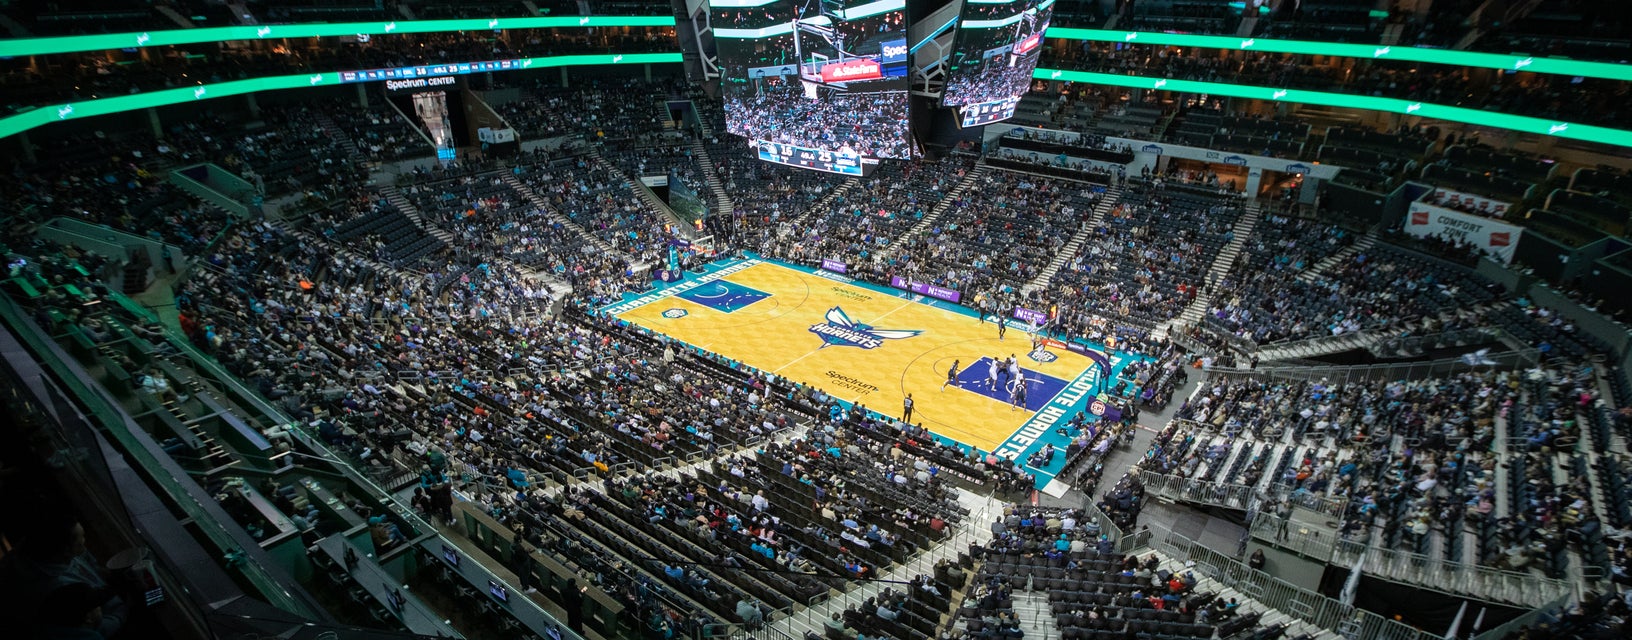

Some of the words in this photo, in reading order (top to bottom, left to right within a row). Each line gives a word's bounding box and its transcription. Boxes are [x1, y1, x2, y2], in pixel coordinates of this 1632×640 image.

[883, 45, 907, 58] Spec
[386, 80, 427, 91] Spectrum
[428, 76, 455, 86] CENTER
[781, 146, 793, 157] 16
[818, 151, 832, 162] 25
[1437, 215, 1484, 233] COMFORT
[605, 281, 698, 314] CHARLOTTE
[697, 259, 762, 283] HORNETS
[812, 323, 880, 348] HORNETS
[826, 370, 878, 391] Spectrum
[832, 380, 870, 395] CENTER
[996, 406, 1067, 460] HORNETS
